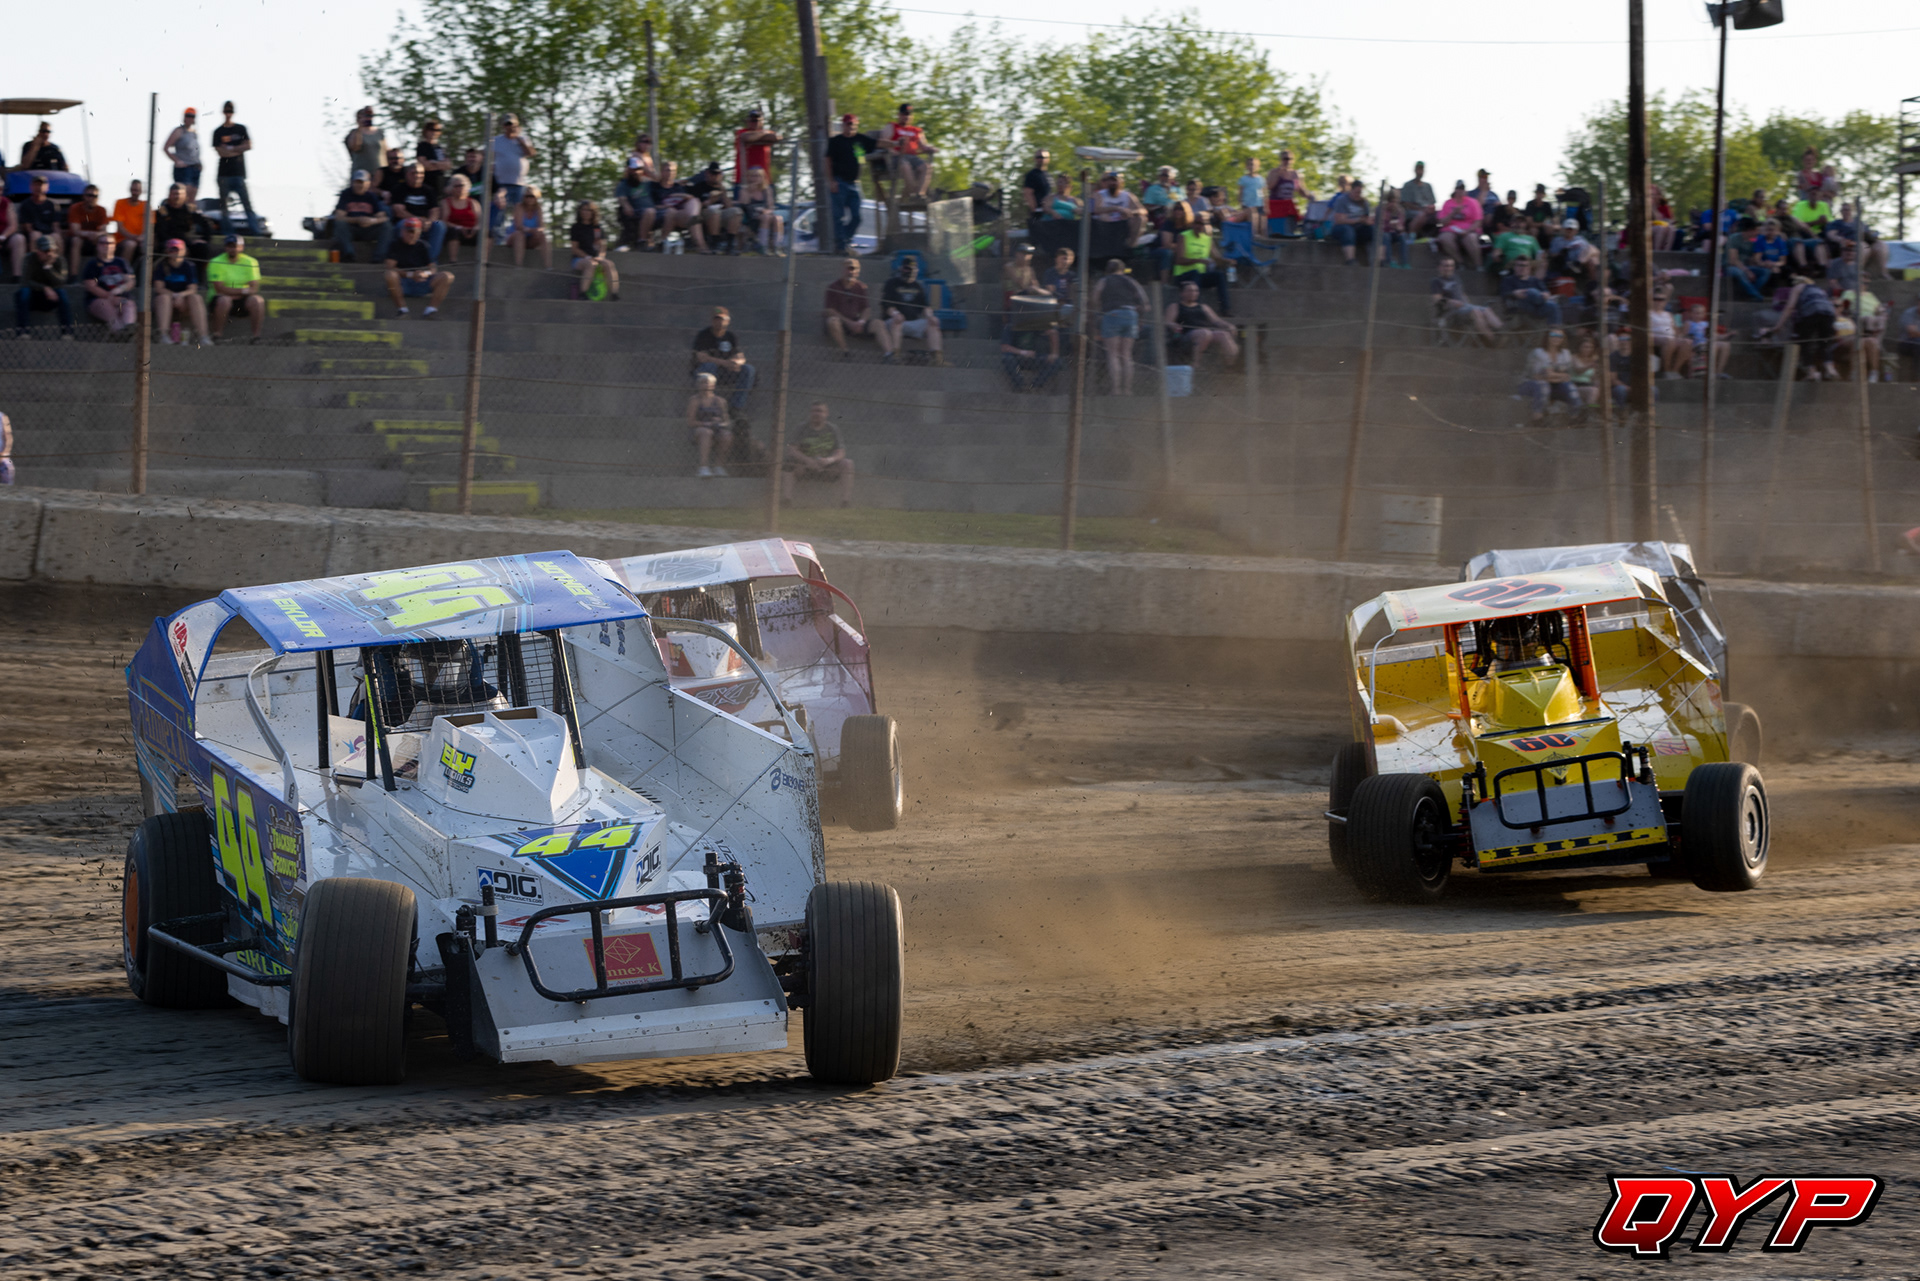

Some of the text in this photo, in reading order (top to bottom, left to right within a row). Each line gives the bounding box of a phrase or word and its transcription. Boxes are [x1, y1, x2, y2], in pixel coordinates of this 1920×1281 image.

[360, 564, 515, 628] 44
[272, 597, 326, 639] EIKLOR
[212, 772, 273, 927] 44
[513, 823, 641, 858] 44
[272, 852, 297, 879] PRODUCTS
[606, 961, 660, 977] nnex K
